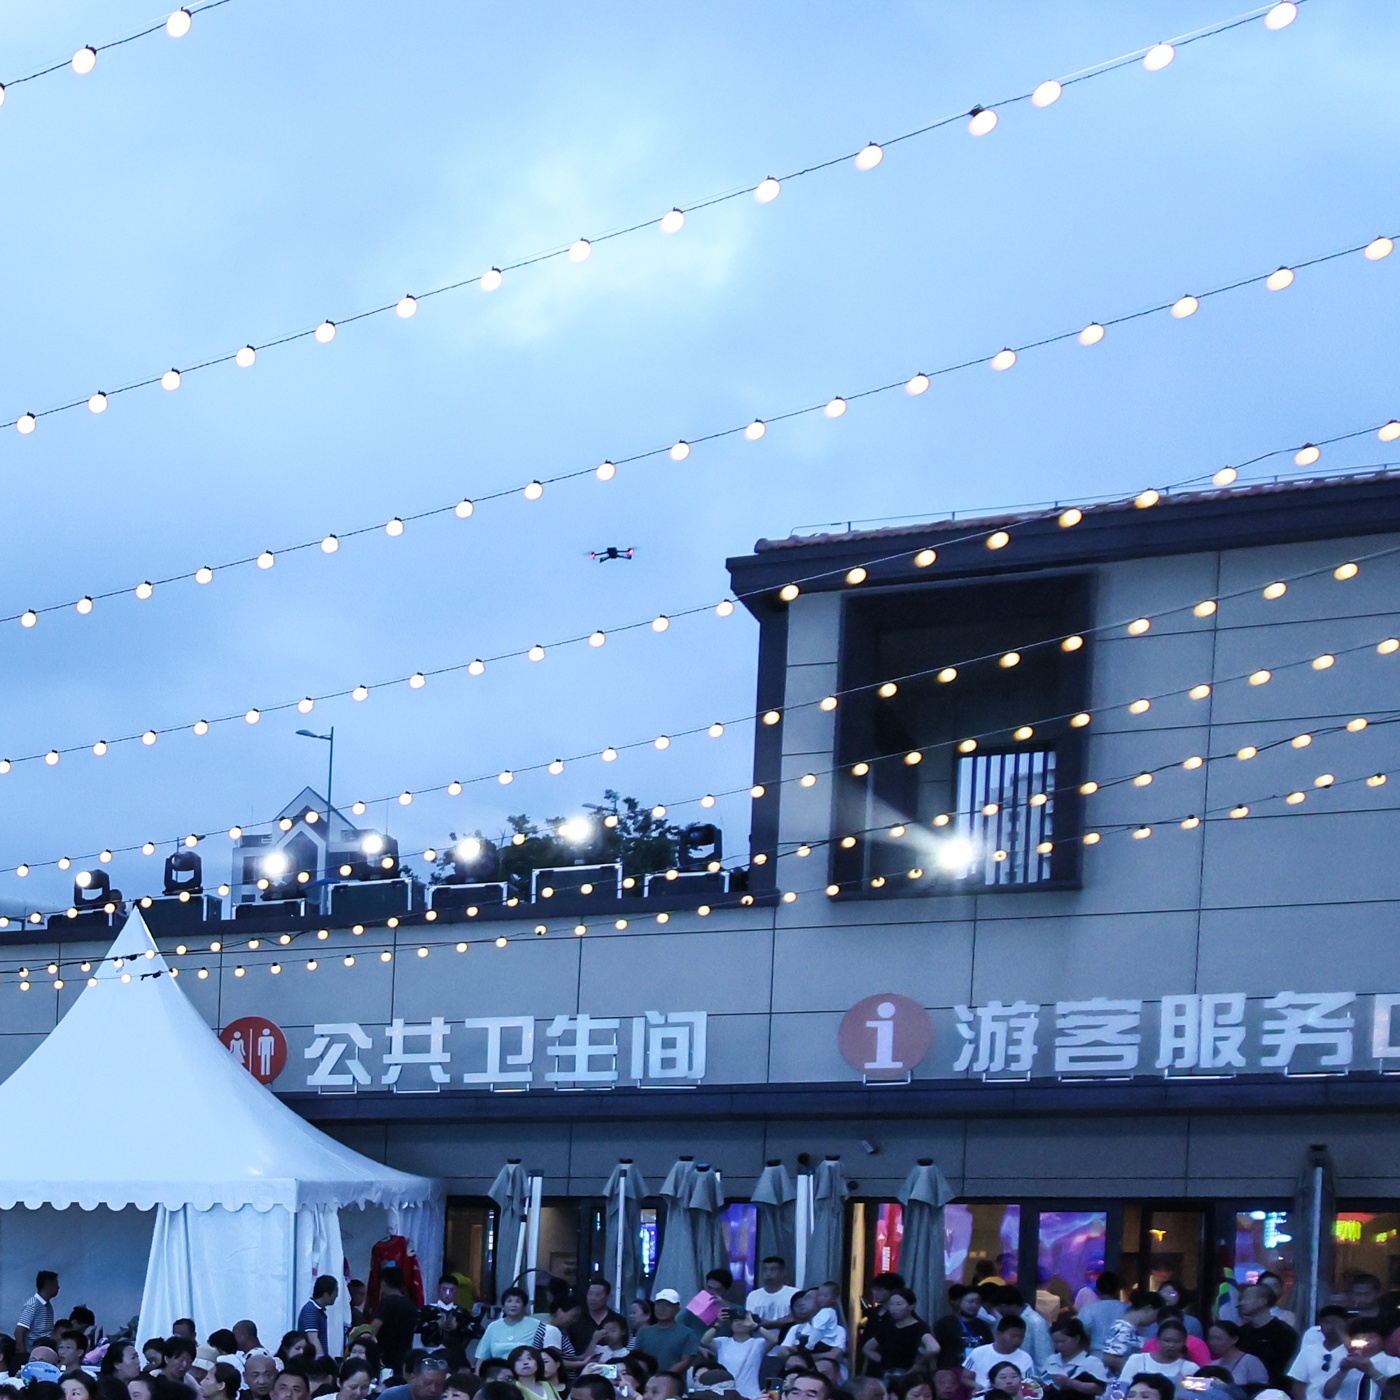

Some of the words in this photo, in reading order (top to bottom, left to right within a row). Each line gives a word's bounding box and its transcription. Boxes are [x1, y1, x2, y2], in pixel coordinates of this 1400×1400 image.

[304, 1010, 708, 1086] 公共卫生间
